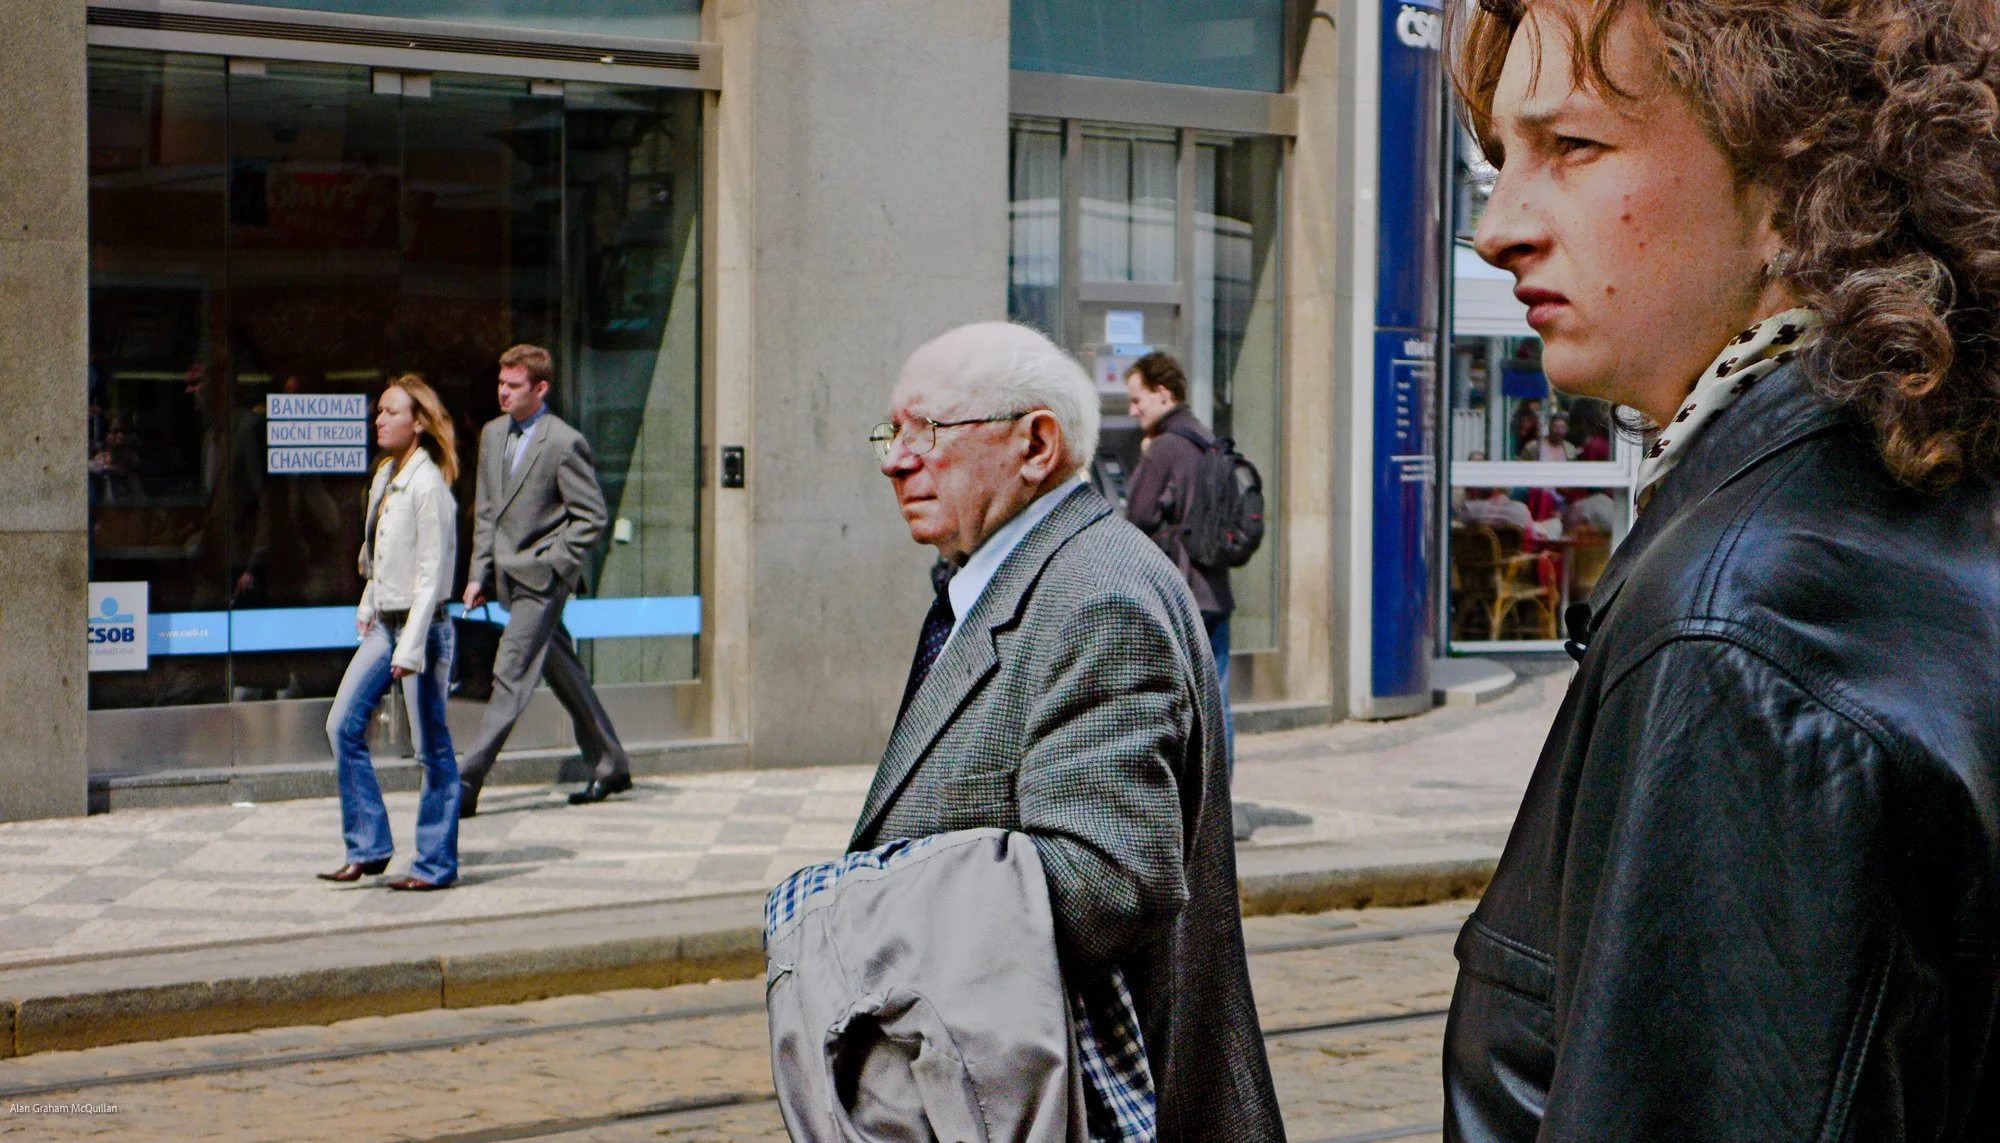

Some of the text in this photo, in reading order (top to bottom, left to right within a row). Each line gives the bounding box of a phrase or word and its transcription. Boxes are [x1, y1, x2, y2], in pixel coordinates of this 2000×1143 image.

[271, 397, 362, 416] BANKOMAT
[271, 422, 362, 441] NOČNÍ TREZOR
[270, 450, 363, 469] CHANGEMAT
